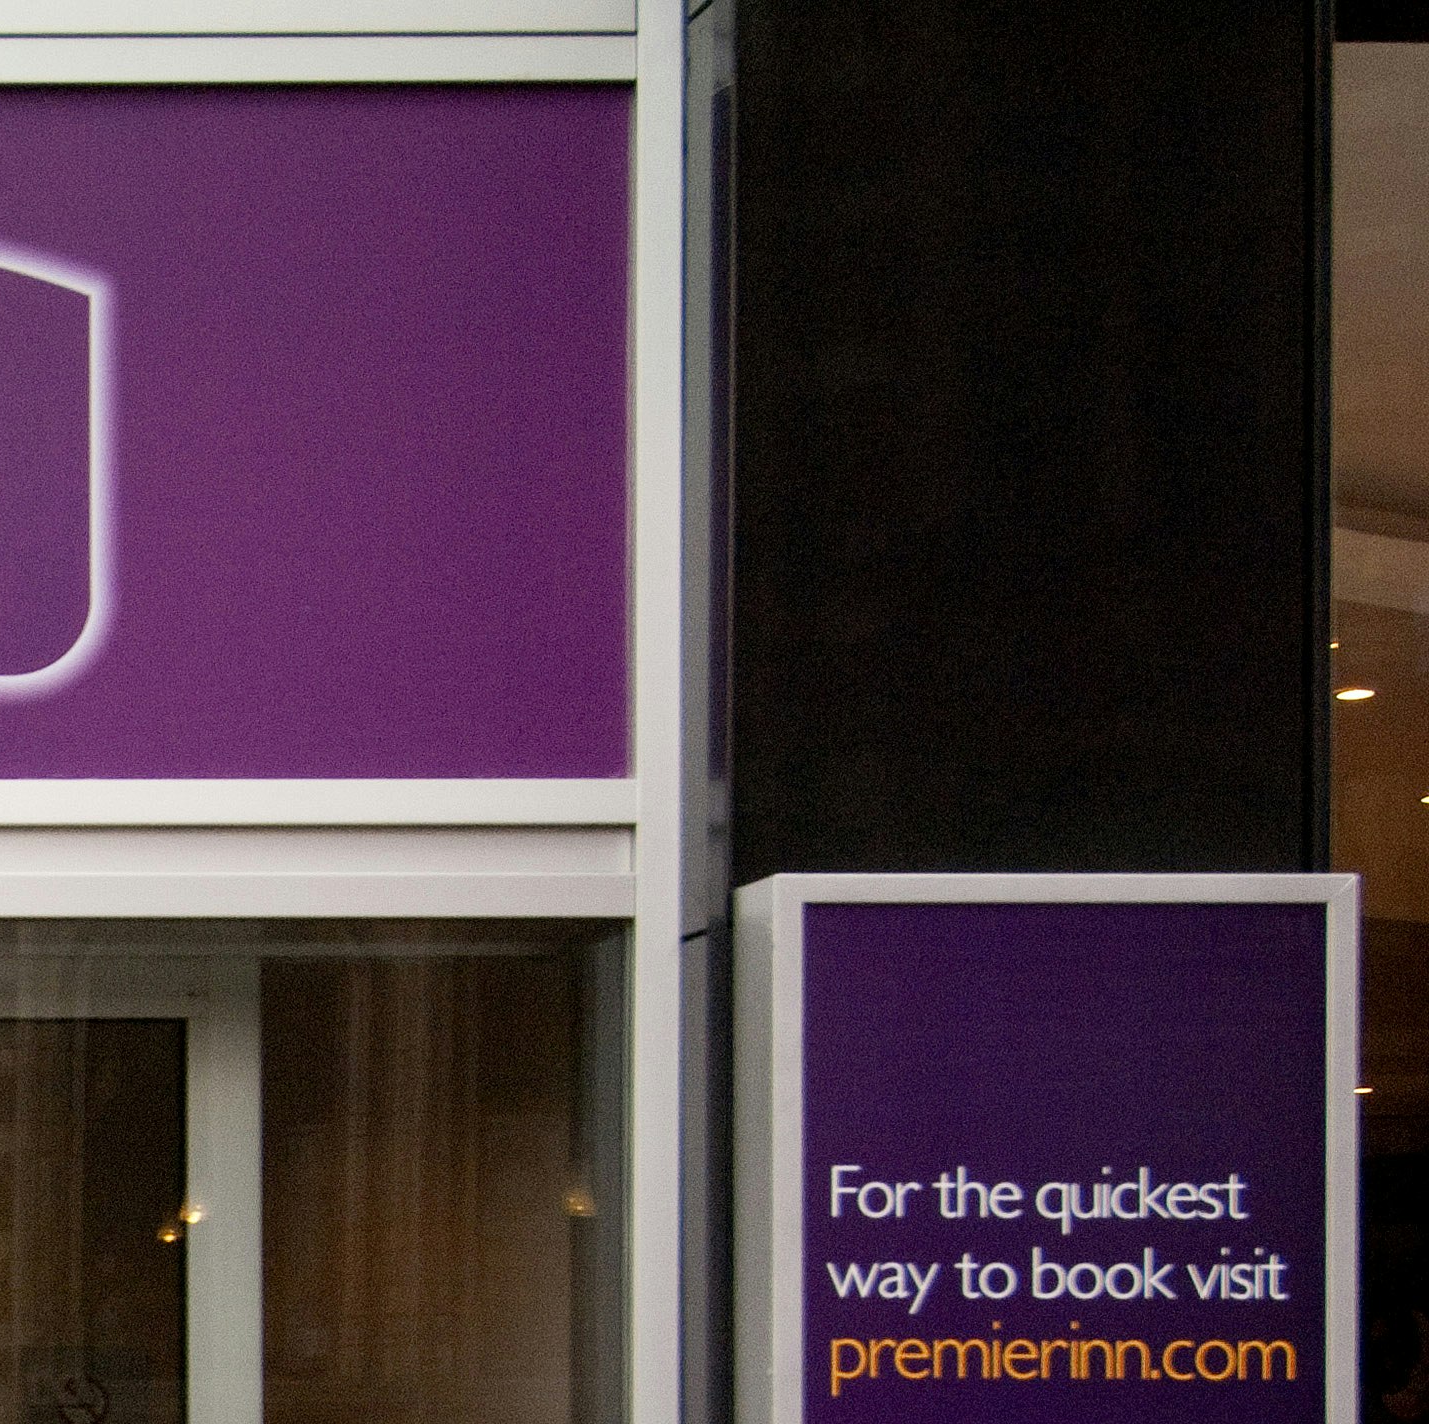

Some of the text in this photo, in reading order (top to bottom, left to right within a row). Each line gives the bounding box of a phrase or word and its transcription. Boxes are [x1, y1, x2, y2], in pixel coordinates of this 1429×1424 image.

[830, 1164, 1249, 1235] For the quickest
[826, 1246, 1289, 1315] way to book visit
[830, 1320, 1296, 1397] premierinn.com
